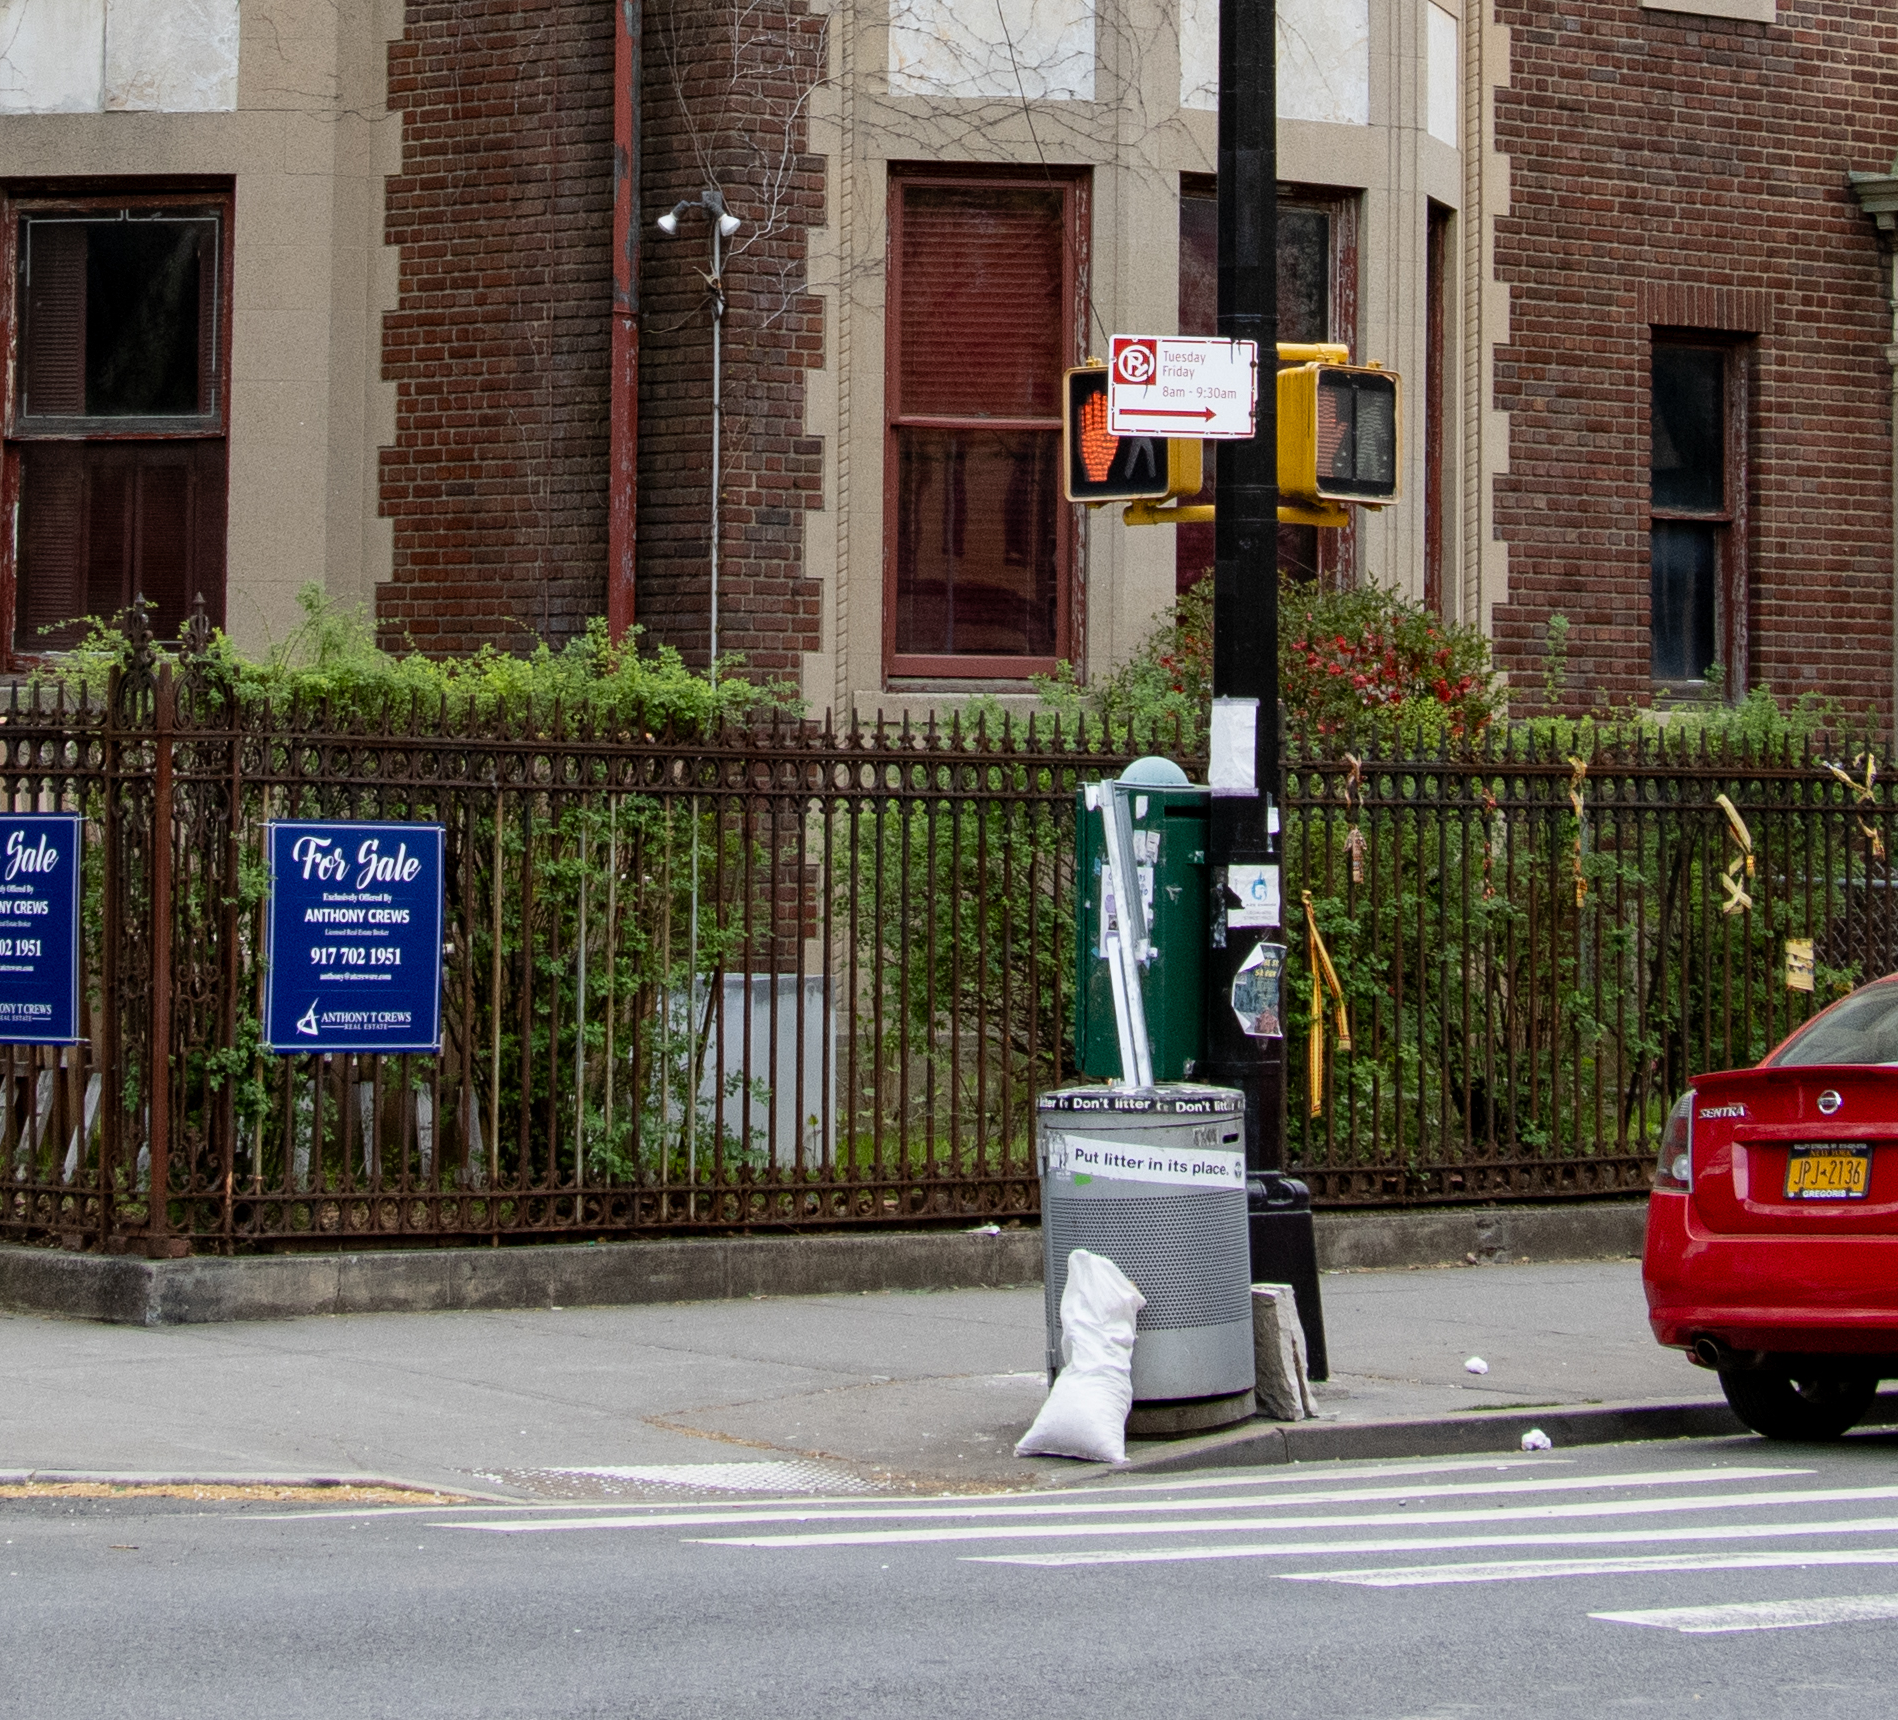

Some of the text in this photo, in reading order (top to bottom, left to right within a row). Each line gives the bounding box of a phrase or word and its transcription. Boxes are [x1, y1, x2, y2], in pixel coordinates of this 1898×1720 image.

[1163, 351, 1206, 365] Tuesday
[1163, 366, 1195, 380] Friday
[1163, 386, 1185, 397] 8am
[1197, 386, 1237, 399] 9:30am
[5, 830, 59, 881] Sale
[292, 836, 422, 890] For Sale
[6, 885, 25, 893] Offered
[26, 885, 34, 895] By
[323, 893, 392, 904] Exclusively Offered By
[14, 901, 49, 915] CREWS
[304, 908, 410, 924] ANTHONY CREWS
[15, 940, 41, 956] 1951
[311, 947, 401, 965] 917 702 1951
[17, 1003, 23, 1014] T
[24, 1004, 52, 1015] CREWS
[321, 1012, 412, 1023] ANTHONY T CREWS
[1073, 1097, 1109, 1109] Don't
[1115, 1098, 1151, 1110] litter
[1175, 1101, 1211, 1113] Don't
[1698, 1105, 1745, 1119] SENTRA
[1075, 1148, 1229, 1176] Put litter in its place.
[1802, 1189, 1847, 1198] GREGORIS
